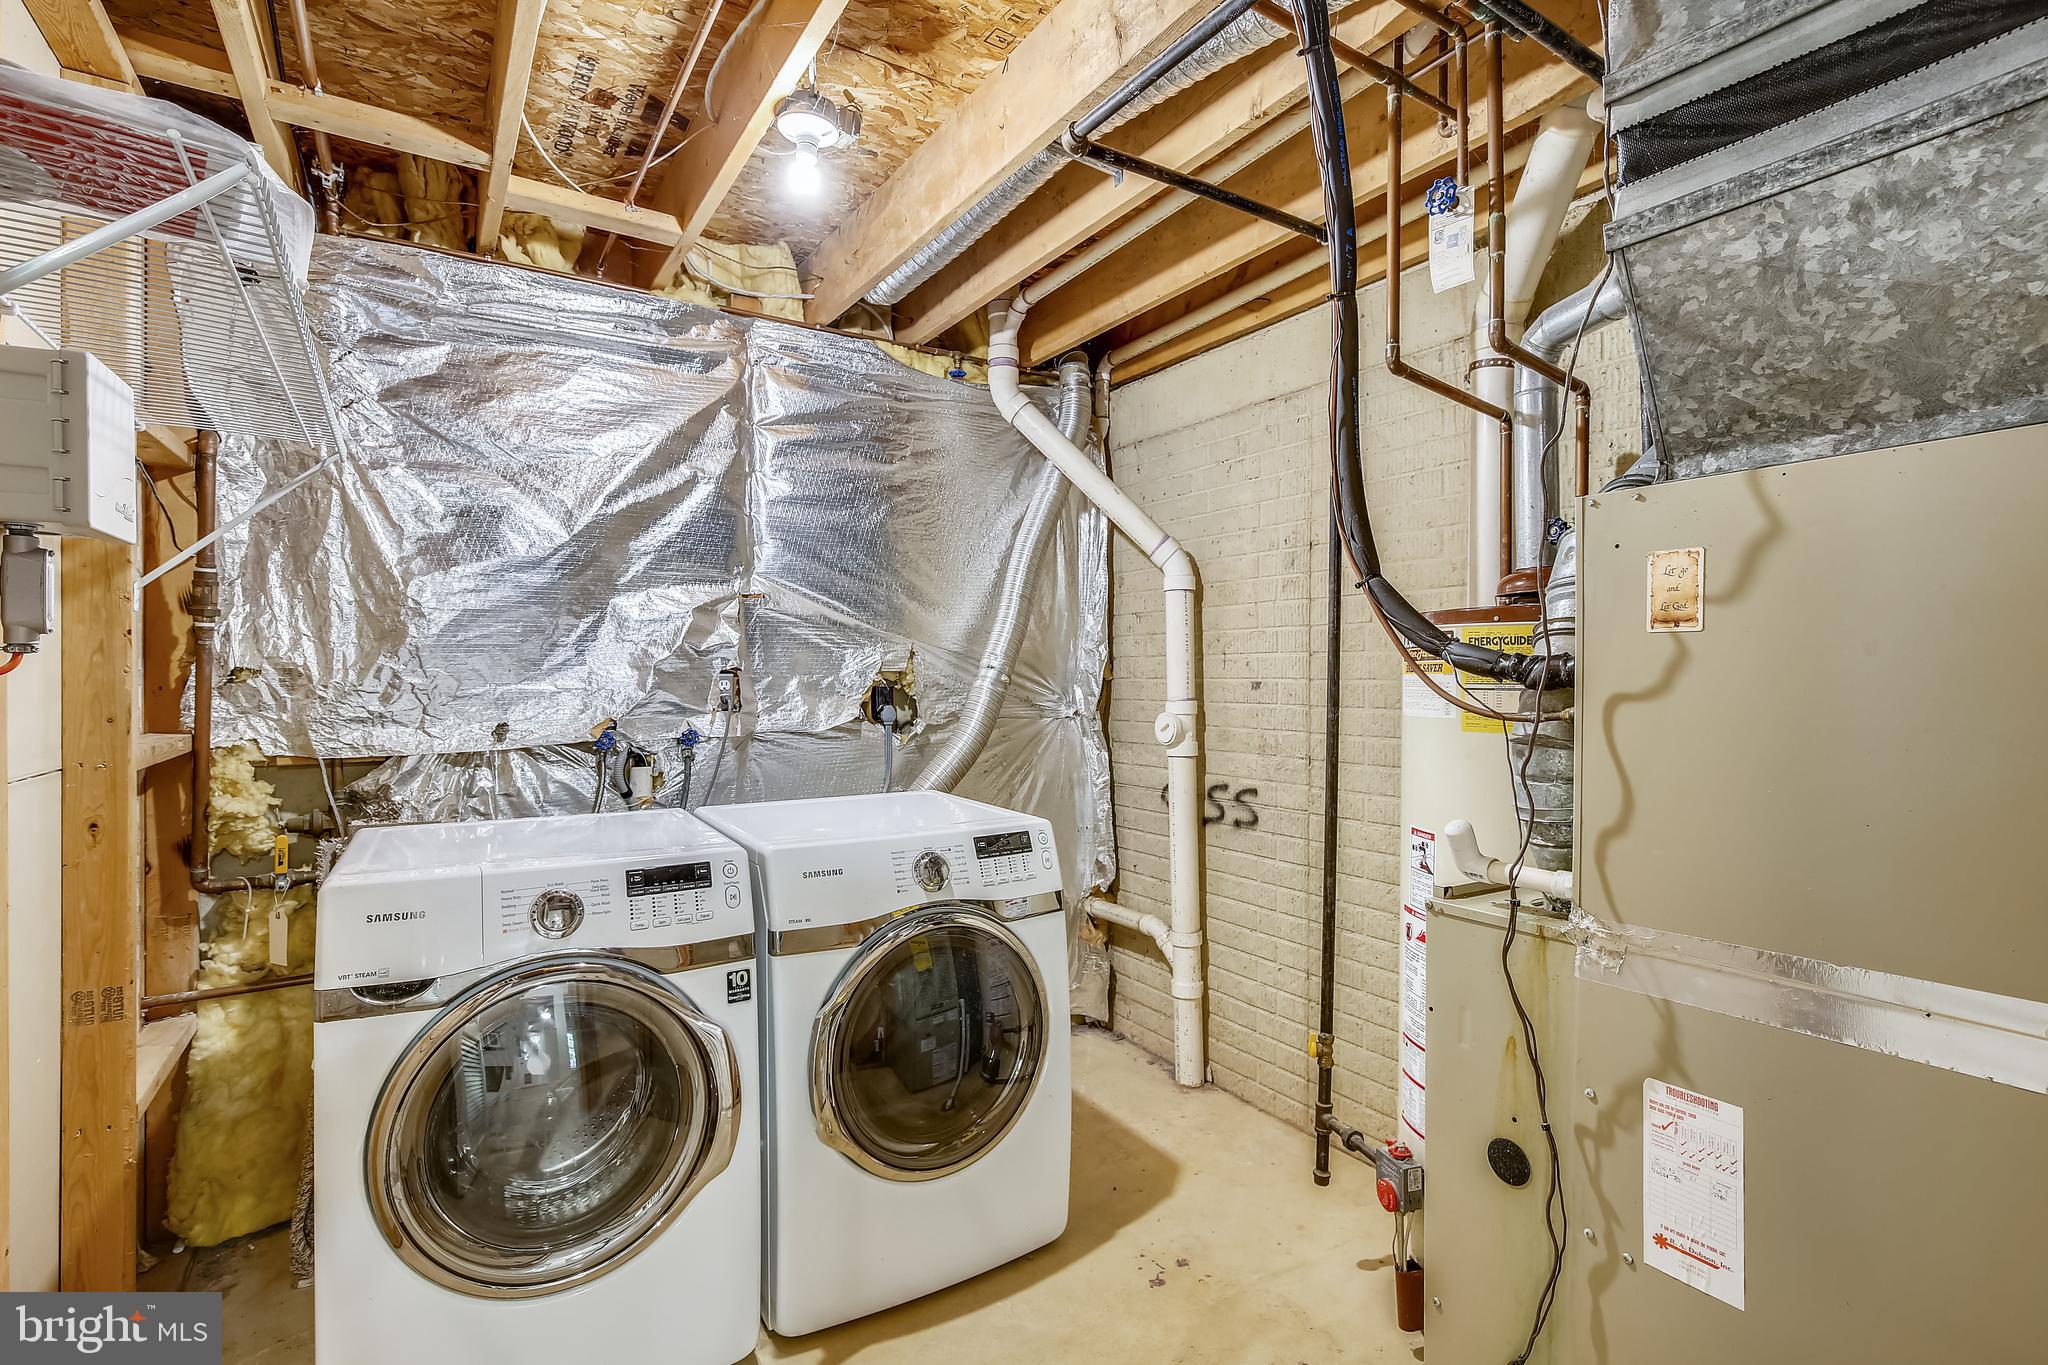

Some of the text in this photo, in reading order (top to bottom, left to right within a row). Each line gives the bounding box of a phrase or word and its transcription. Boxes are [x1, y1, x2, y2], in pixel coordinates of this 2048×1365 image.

[1664, 564, 1688, 578] Let go
[1667, 583, 1680, 592] and
[1660, 601, 1689, 612] Let God
[1469, 635, 1533, 650] ENERGYGUIDE
[802, 868, 844, 879] SAMSUNG
[366, 910, 426, 923] SAMSUNG
[355, 971, 377, 979] STEAM
[729, 971, 748, 987] 10
[1666, 1086, 1719, 1112] TROUBLESHOOTING
[1720, 1261, 1735, 1273] Inc.
